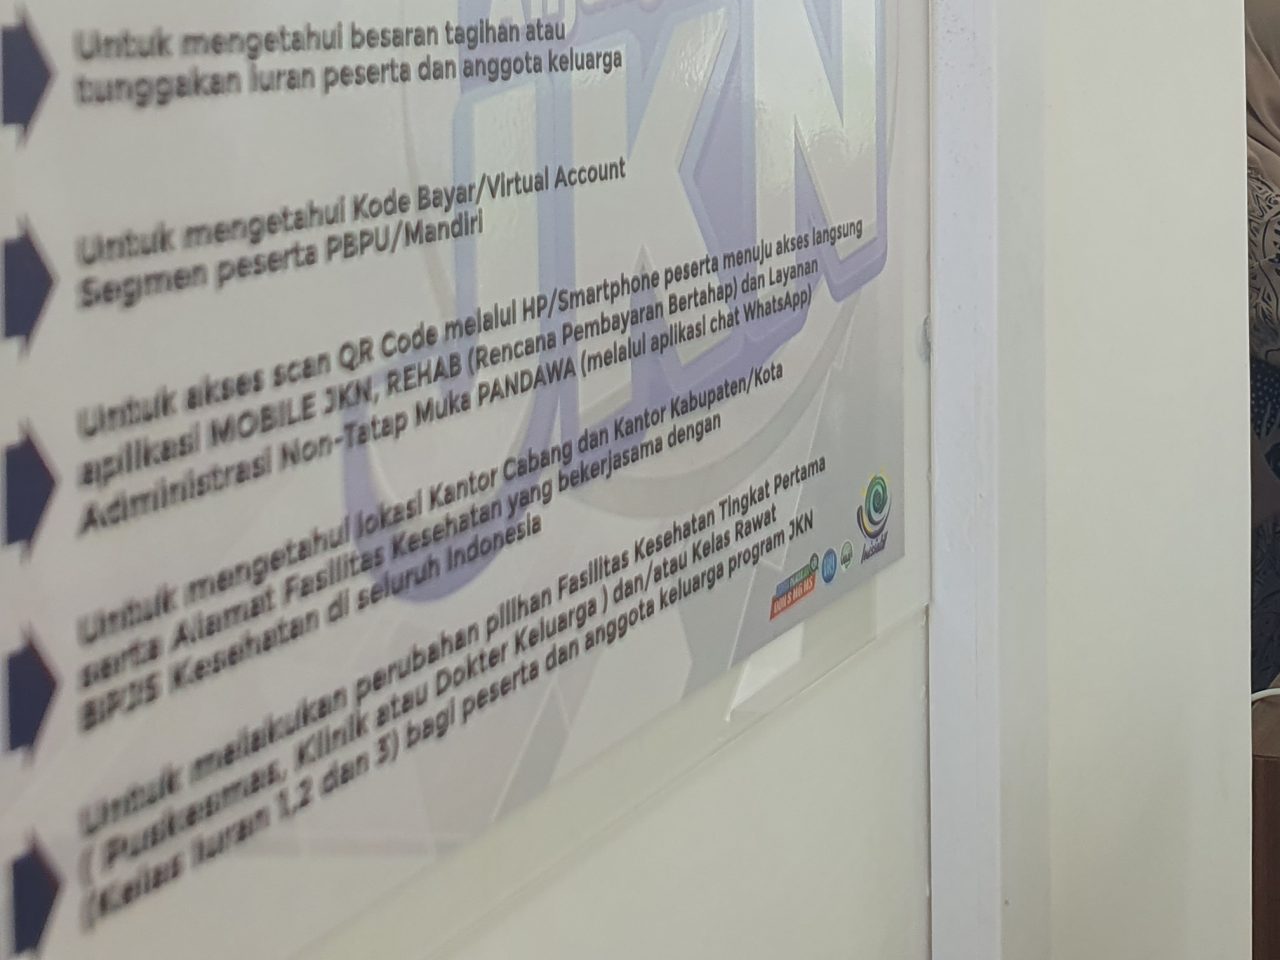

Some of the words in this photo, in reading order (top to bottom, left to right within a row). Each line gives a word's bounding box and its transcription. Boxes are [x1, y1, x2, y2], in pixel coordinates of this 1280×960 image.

[75, 26, 171, 61] Untuk
[181, 21, 343, 61] mengetahui
[351, 21, 438, 50] besaran
[445, 20, 520, 50] tagihan
[526, 20, 566, 42] atau
[76, 66, 240, 109] tunggakan
[323, 59, 411, 93] peserta
[418, 55, 456, 81] dan
[462, 51, 543, 83] anggota
[548, 48, 622, 74] keluarga
[76, 222, 174, 267] Untuk
[184, 196, 346, 245] mengetahui
[353, 188, 410, 220] Kode
[417, 165, 549, 211] Bayar/Virtual
[554, 157, 626, 187] Account
[79, 263, 207, 311] Segmen
[217, 242, 316, 288] peserta
[326, 209, 483, 262] PBPU/Mandiri
[76, 384, 178, 437] Untuk
[186, 366, 265, 411] akses
[272, 353, 330, 388] scan
[338, 338, 373, 371] QR
[381, 323, 438, 359] Code
[445, 299, 516, 340] melalui
[522, 269, 660, 320] HP/Smartphone
[664, 257, 718, 283] peserta
[723, 241, 771, 272] menuju
[776, 232, 808, 257] akses
[812, 219, 863, 248] langsung
[78, 448, 272, 535] Administrasi
[280, 411, 408, 471] Non-Tatap
[415, 388, 471, 427] Muka
[478, 359, 576, 407] PANDAWA
[580, 335, 646, 379] (melalui
[651, 312, 707, 353] aplikasi
[710, 308, 740, 332] chat
[743, 284, 812, 321] WhatsApp)
[80, 431, 199, 488] aplikasi
[210, 392, 316, 449] MOBILE
[324, 378, 380, 416] JKN,
[387, 353, 462, 394] REHAB
[467, 330, 557, 375] (Rencana
[562, 301, 663, 344] Pembayaran
[668, 275, 738, 316] Bertahap)
[741, 271, 764, 294] dan
[769, 258, 818, 288] Layanan
[77, 582, 178, 644] Untuk
[184, 516, 350, 603] mengetahui
[357, 493, 422, 537] lokasi
[430, 468, 498, 512] Kantor
[502, 437, 573, 482] Cabang
[577, 424, 609, 453] dan
[614, 404, 666, 437] Kantor
[670, 361, 783, 418] Kabupaten/Kota
[80, 635, 163, 689] serta
[171, 594, 276, 649] Alamat
[284, 549, 385, 606] Fasilitas
[391, 498, 502, 560] Kesehatan
[506, 480, 553, 517] yang
[558, 437, 664, 494] bekerjasama
[667, 412, 722, 449] dengan
[80, 672, 161, 734] BPJS
[170, 608, 320, 692] Kesehatan
[327, 594, 350, 624] di
[357, 557, 440, 610] seluruh
[446, 514, 543, 573] Indonesia
[80, 764, 182, 837] Untuk
[189, 688, 347, 781] melakukan
[356, 622, 479, 702] perubahan
[485, 586, 552, 641] pilihan
[558, 550, 630, 596] Fasilitas
[634, 509, 715, 561] Kesehatan
[719, 480, 769, 526] Tingkat
[774, 453, 826, 495] Pertama
[80, 854, 184, 930] (Kelas
[320, 750, 369, 795] dan
[375, 737, 401, 767] 3)
[406, 703, 455, 749] bagi
[462, 658, 539, 723] peserta
[545, 641, 580, 671] dan
[584, 605, 656, 652] anggota
[659, 569, 724, 618] keluarga
[728, 534, 785, 577] program
[789, 510, 814, 546] JKN
[295, 715, 368, 770] Klinik
[376, 688, 428, 726] atau
[435, 640, 508, 697] Dokter
[514, 602, 597, 653] Keluarga
[613, 550, 688, 606] dan/atau
[692, 536, 729, 570] Kelas
[735, 505, 777, 542] Rawat
